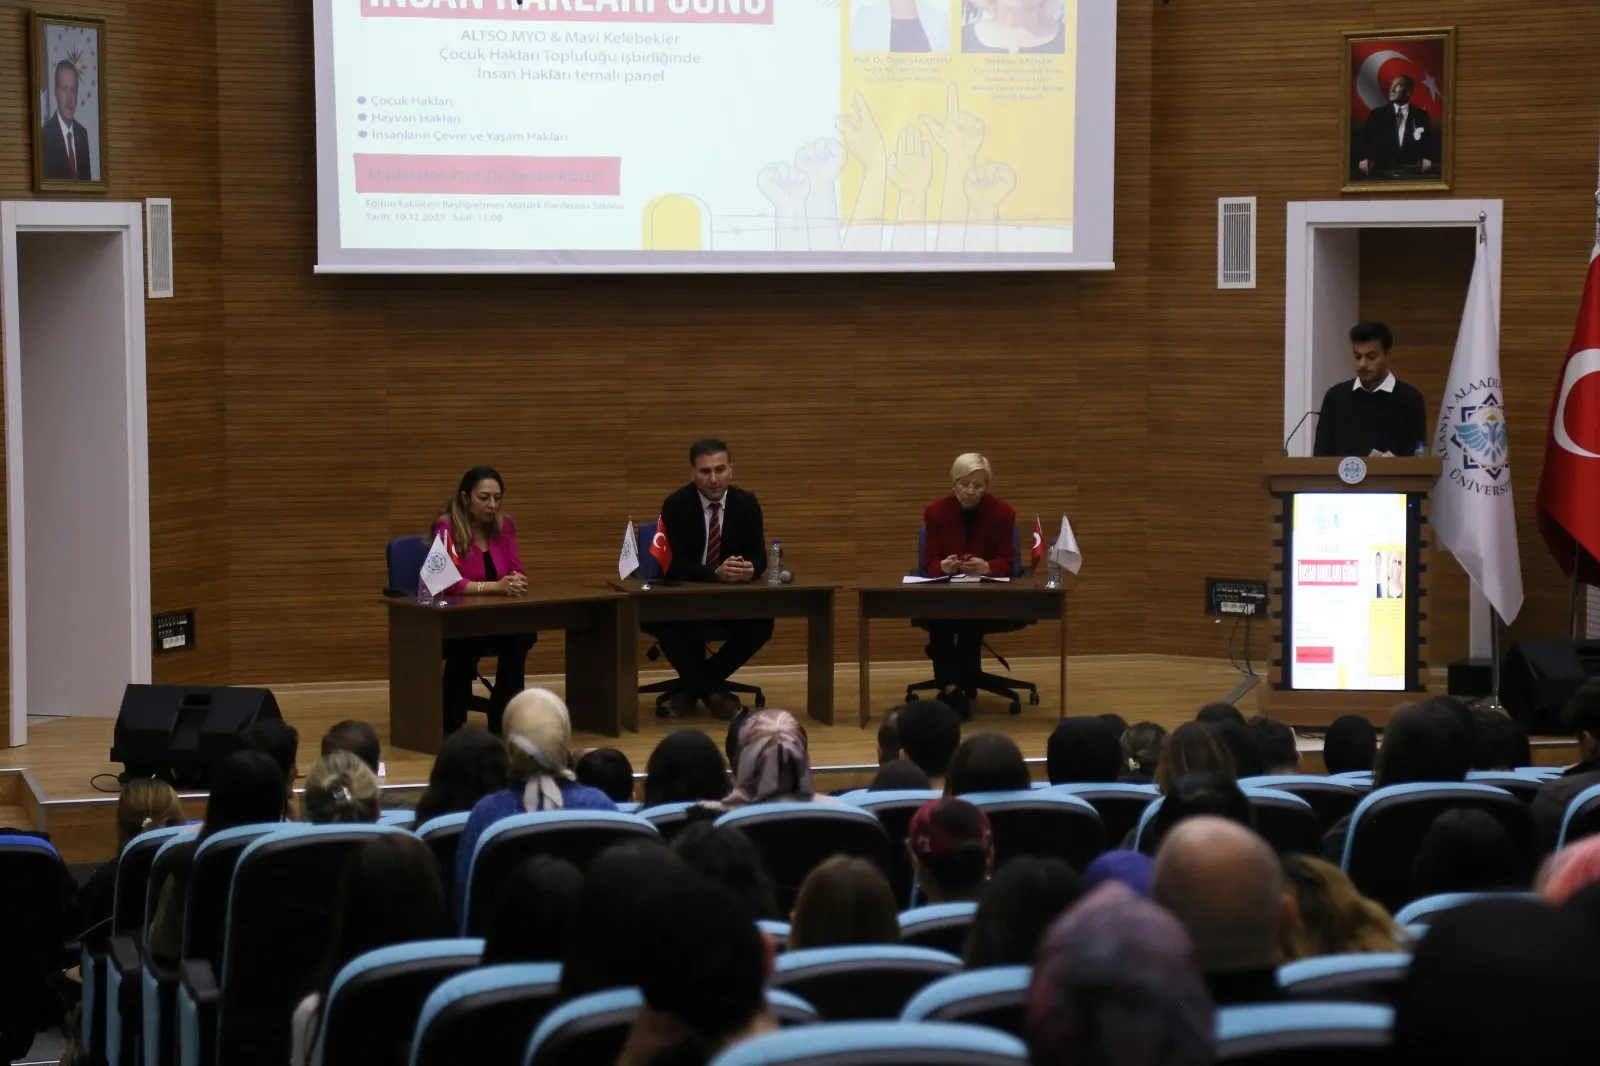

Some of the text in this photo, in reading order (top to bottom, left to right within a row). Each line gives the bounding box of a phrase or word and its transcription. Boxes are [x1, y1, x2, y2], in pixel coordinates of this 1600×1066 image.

[460, 30, 680, 45] ALTSO MYO & Mavi Kelebekler
[439, 48, 701, 65] Çocuk Hakları Topluluğu işbirliğinde
[477, 66, 665, 84] İnsan Hakları temalı panel
[371, 95, 453, 107] Çocuk Hakları
[371, 112, 461, 124] Hayvan Hakları
[371, 128, 568, 142] İnsanların Çevre ve Yaşam Hakları
